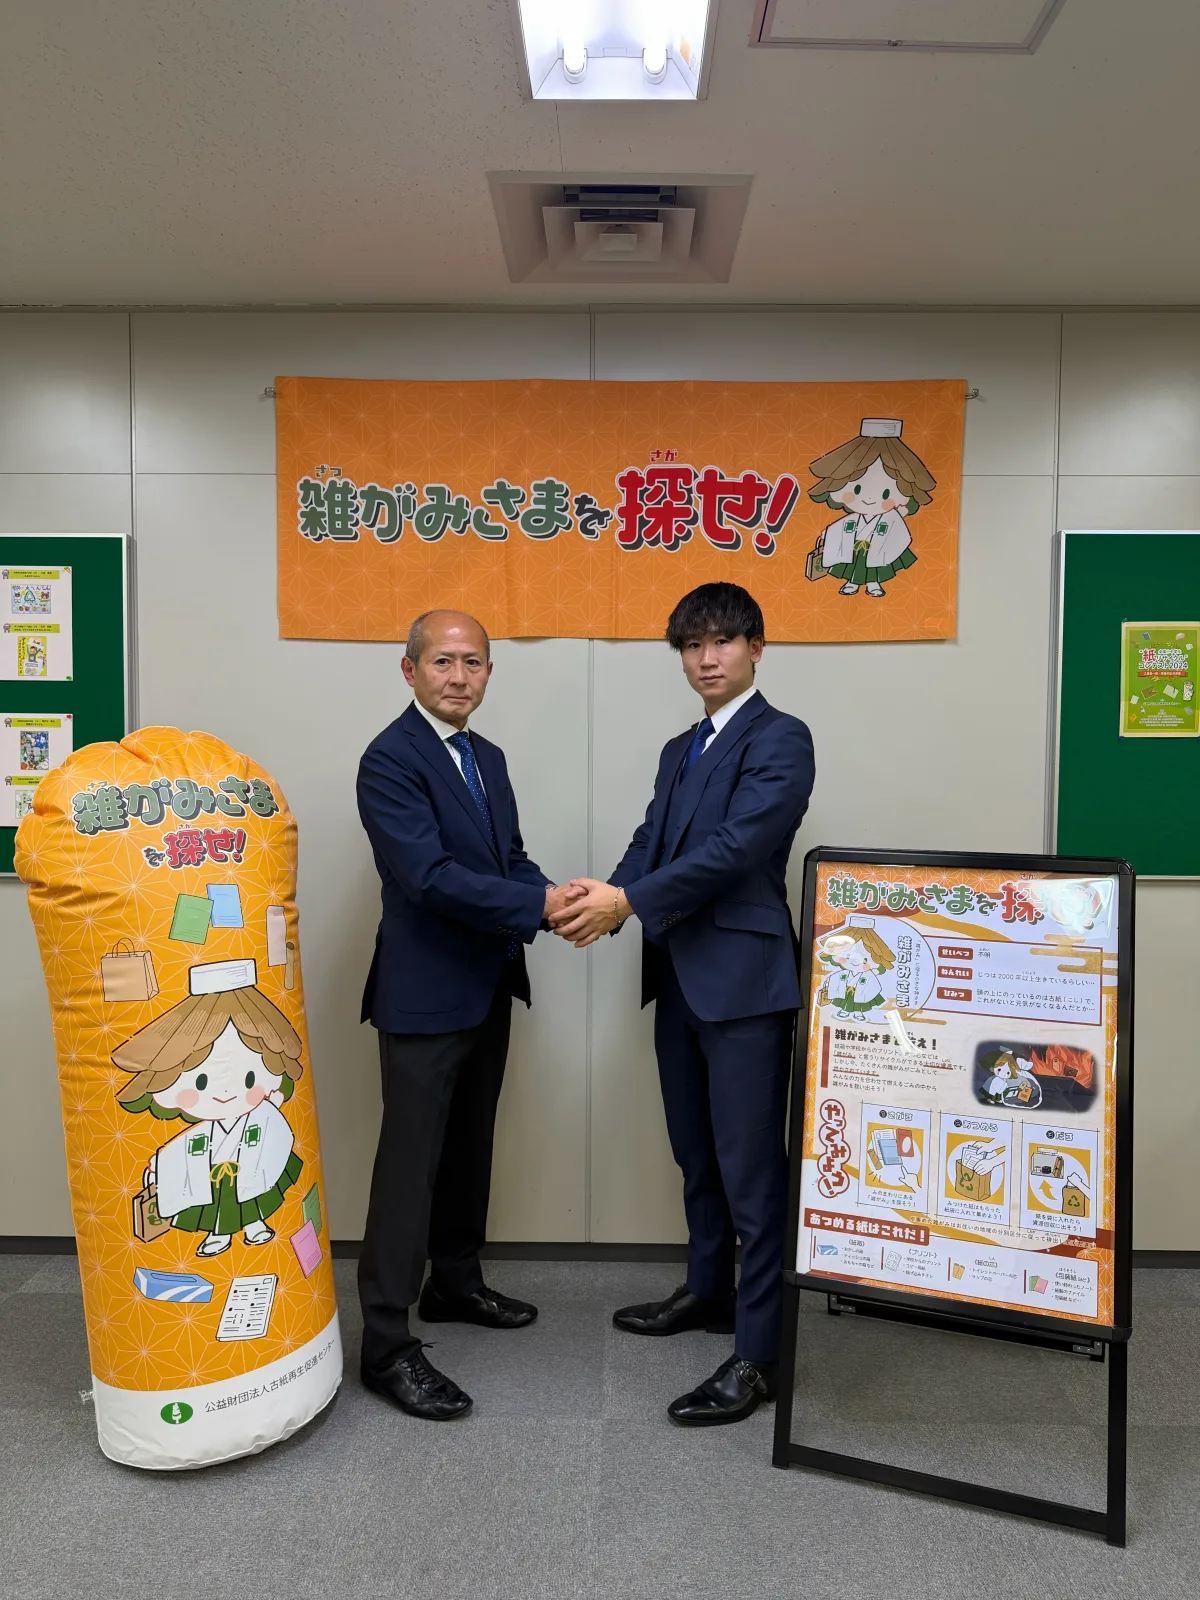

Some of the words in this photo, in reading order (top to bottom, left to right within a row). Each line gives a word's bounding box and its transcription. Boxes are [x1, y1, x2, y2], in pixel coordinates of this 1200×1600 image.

[649, 449, 678, 463] さが
[314, 464, 342, 479] ざつ
[297, 464, 801, 558] 雑がみさまを探せ！
[71, 775, 280, 836] 雑がみさま
[143, 828, 247, 871] を探せ！
[942, 948, 970, 957] せいべつ
[896, 936, 912, 1008] 雑がみさま
[941, 968, 969, 977] ねんれい
[872, 1189, 913, 1200] みのまわりにある
[810, 1213, 925, 1242] あつめる紙はこれだ！
[204, 1339, 335, 1413] 公益財団法人古紙再生促進センター
